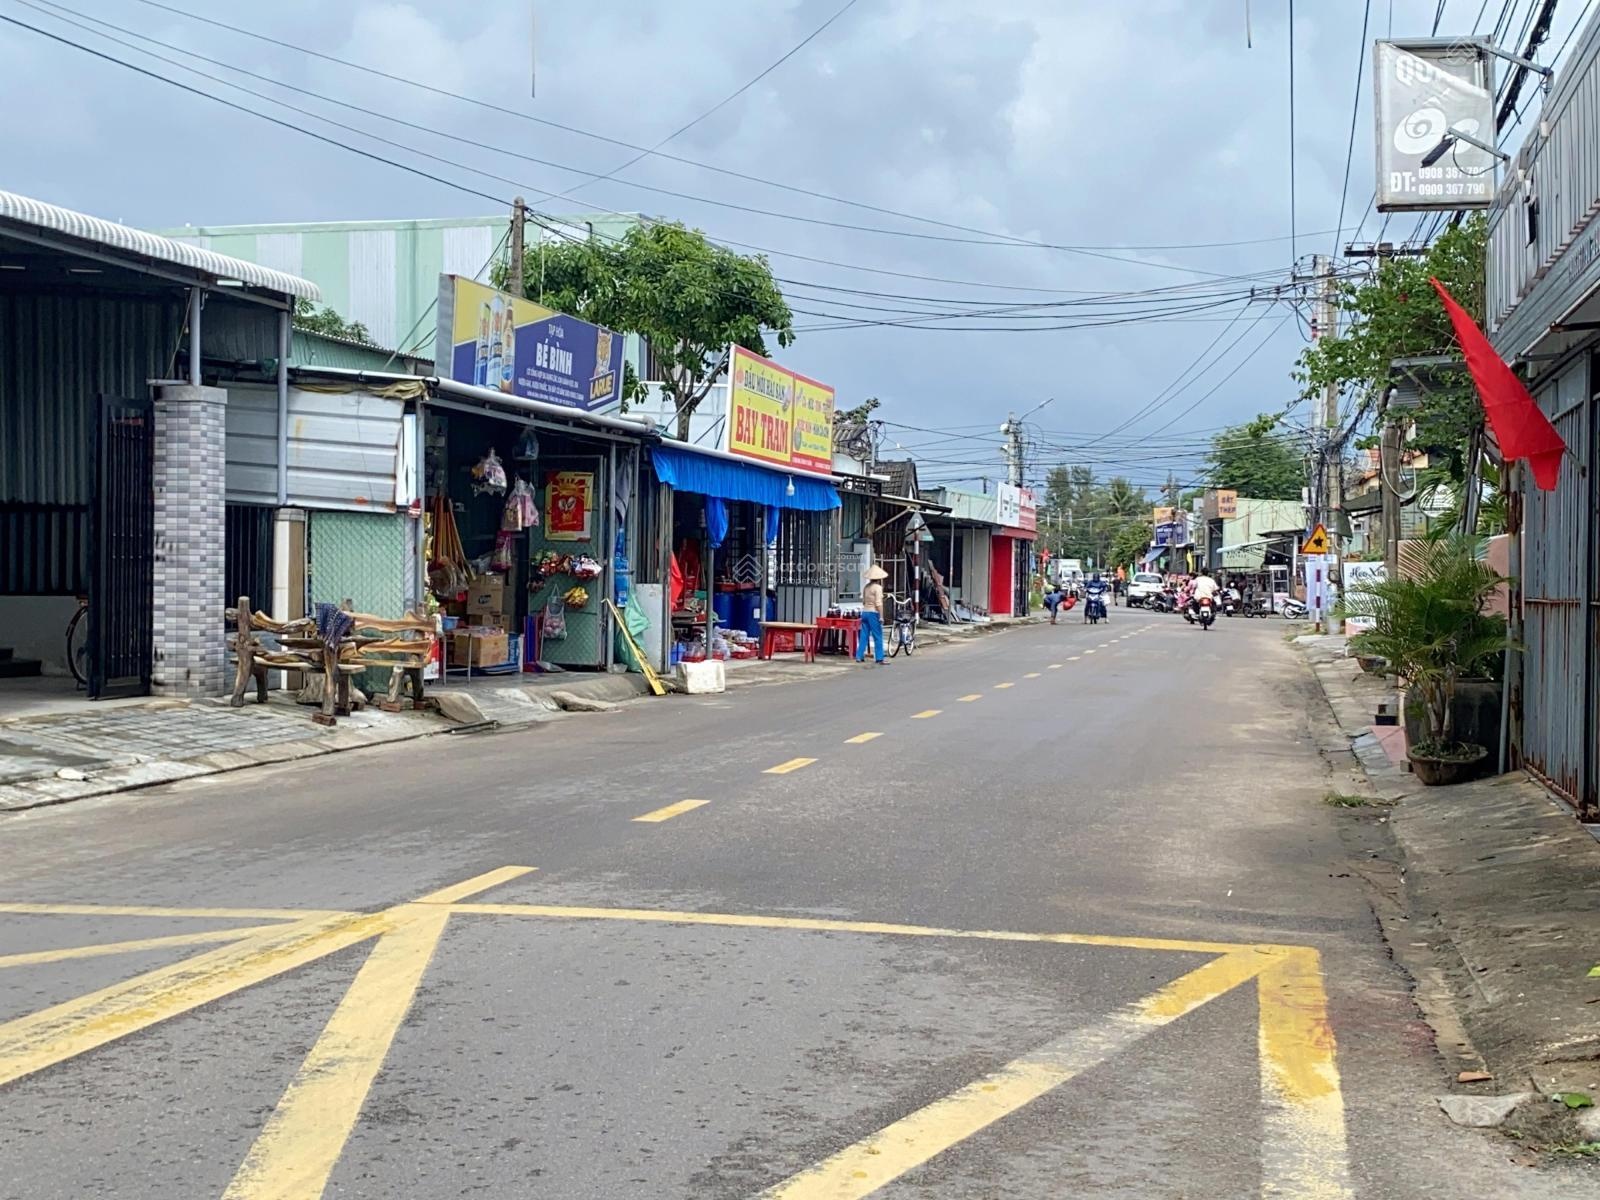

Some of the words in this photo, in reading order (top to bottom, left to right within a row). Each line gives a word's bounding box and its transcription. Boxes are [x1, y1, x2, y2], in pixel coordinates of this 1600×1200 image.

[1418, 184, 1443, 196] 0909
[1446, 183, 1464, 195] 367
[1467, 183, 1486, 195] 790
[536, 338, 549, 368] BÉ
[549, 342, 572, 375] BÌNH
